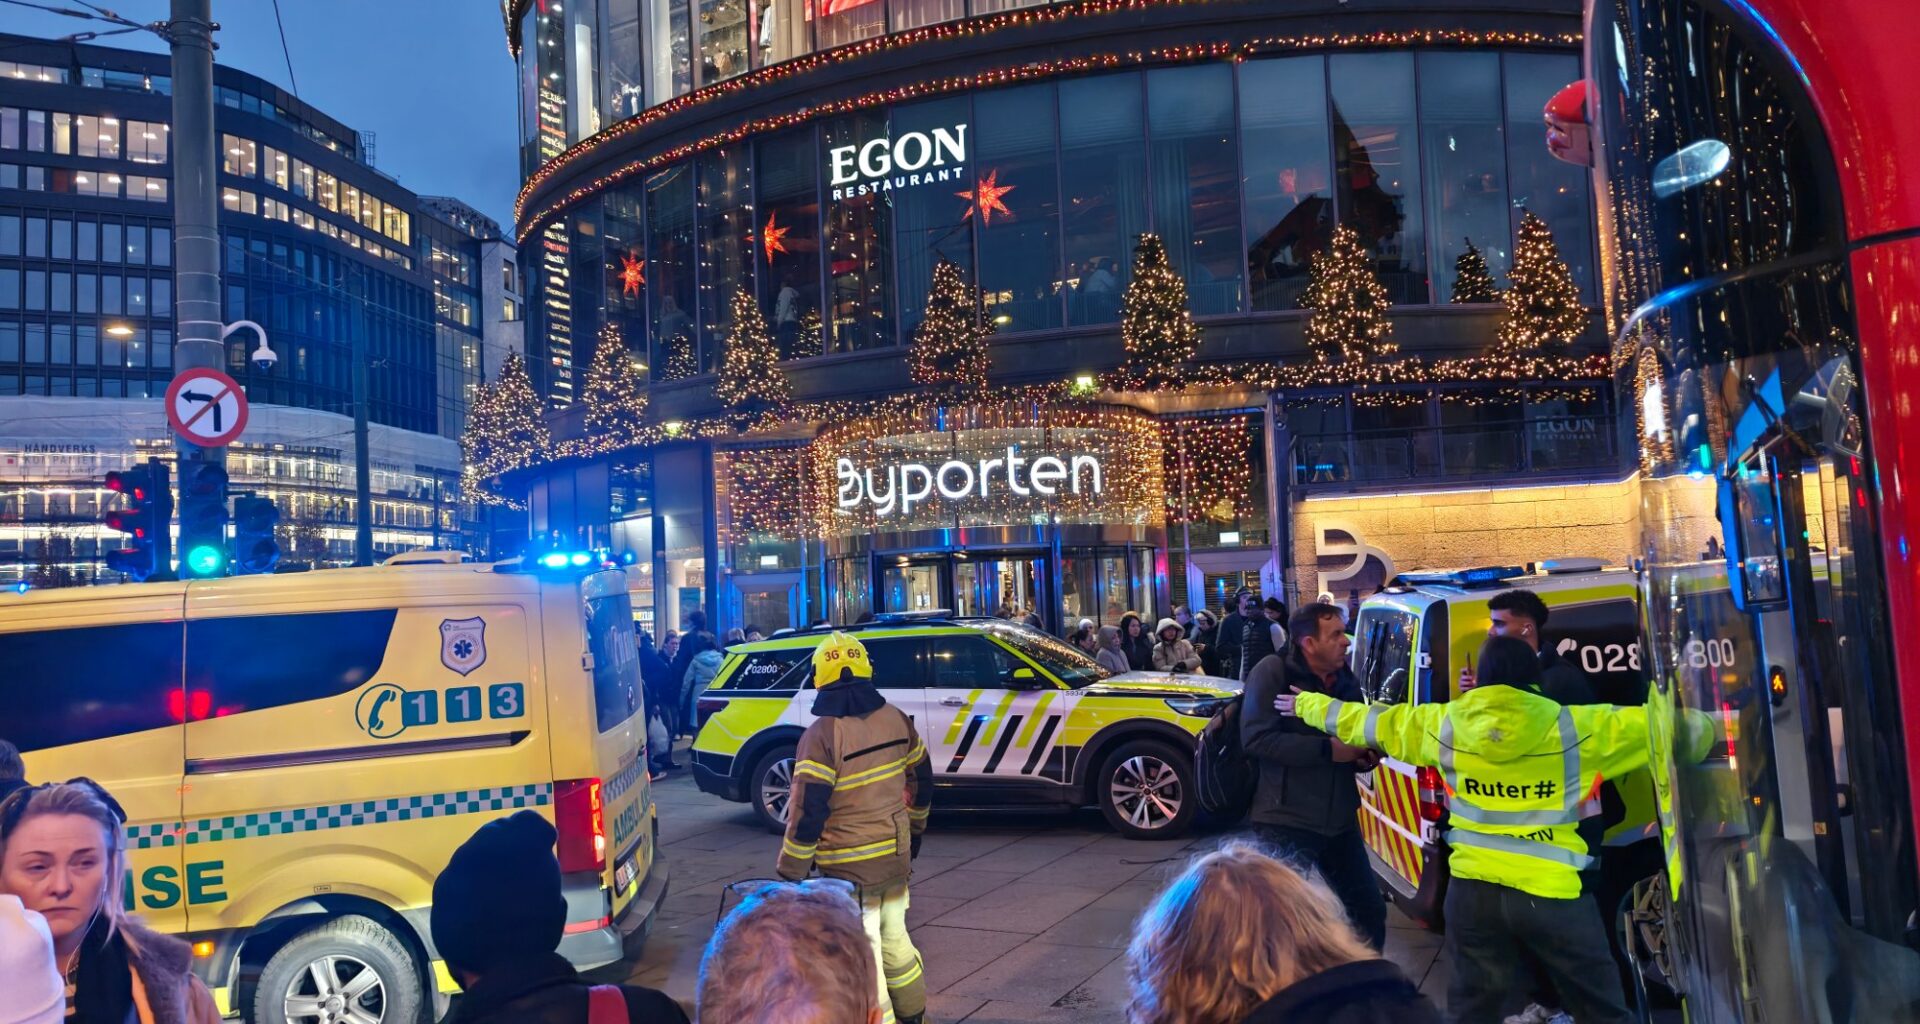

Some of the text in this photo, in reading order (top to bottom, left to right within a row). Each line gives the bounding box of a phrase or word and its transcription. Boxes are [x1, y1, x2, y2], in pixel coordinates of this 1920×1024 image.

[830, 124, 967, 186] EGON
[833, 167, 963, 200] RESTAURANT
[837, 446, 1101, 514] Byporten
[751, 664, 778, 674] 02800
[824, 649, 861, 661] 36 69
